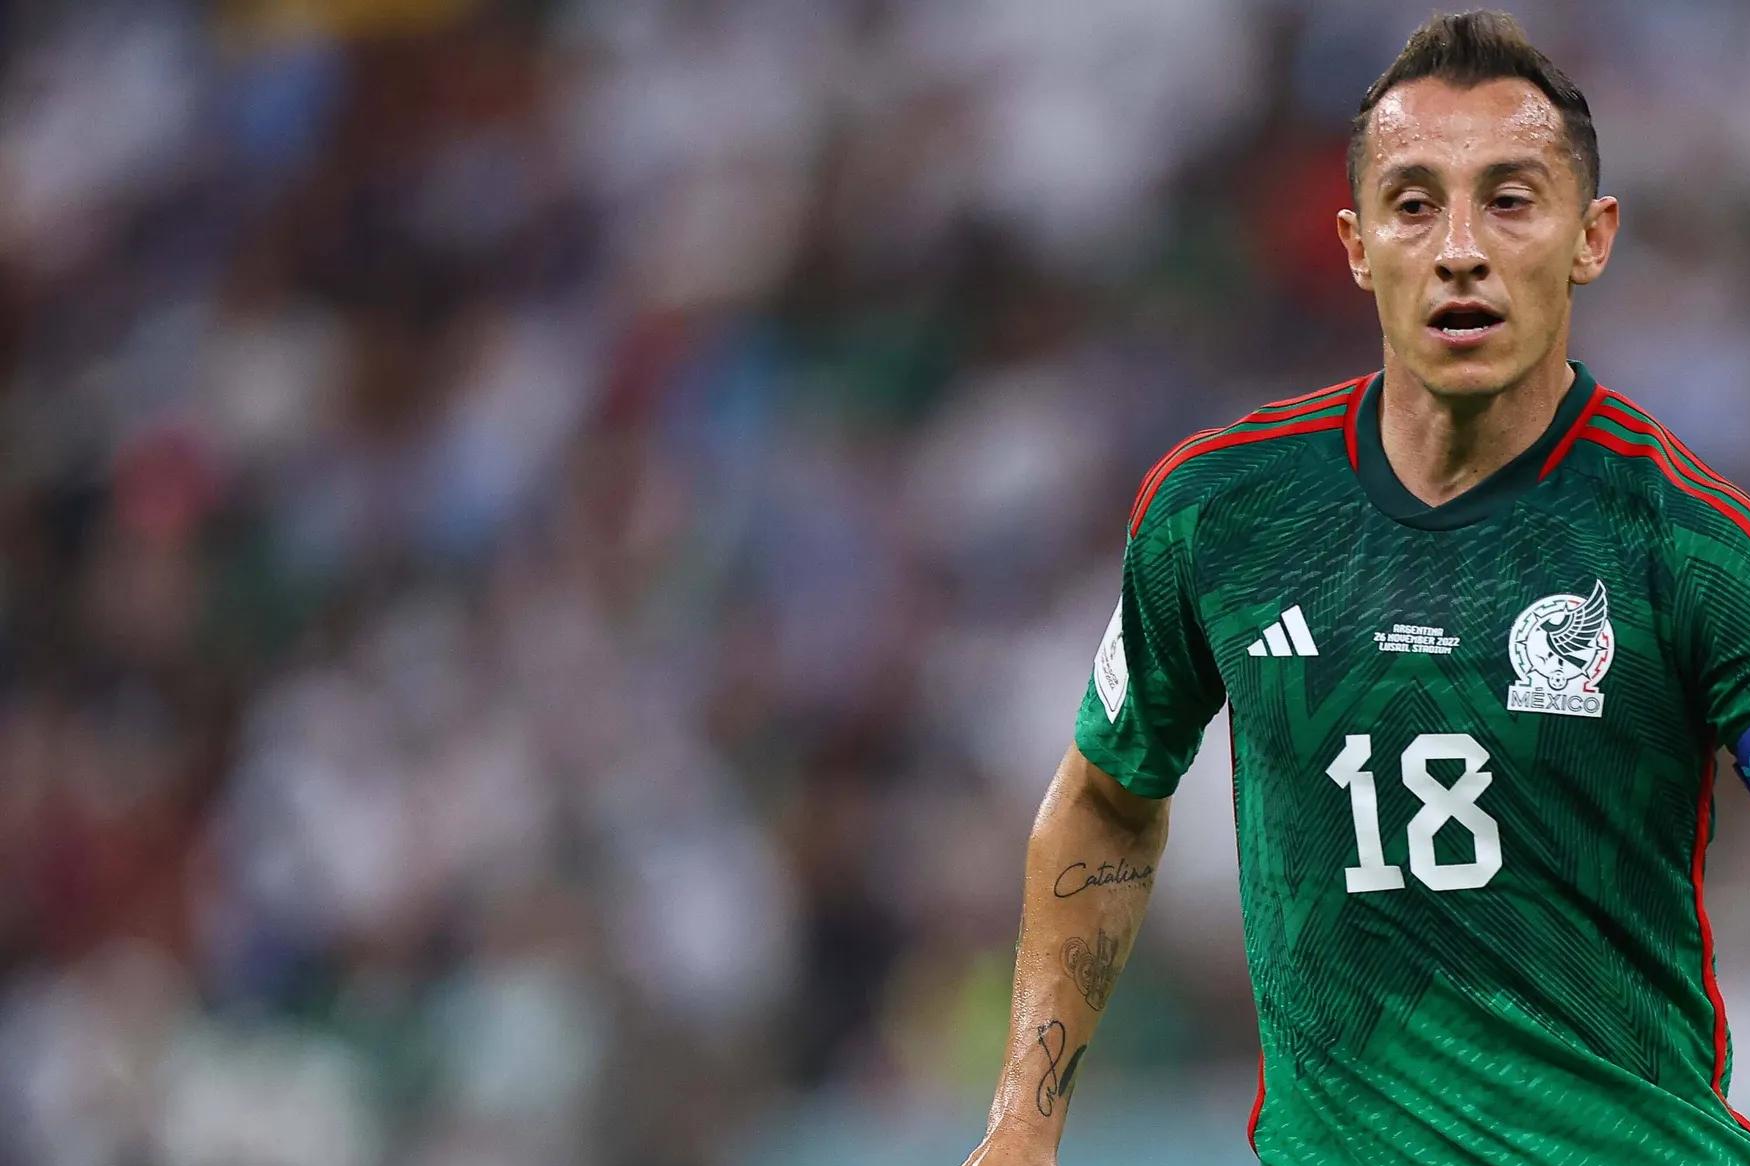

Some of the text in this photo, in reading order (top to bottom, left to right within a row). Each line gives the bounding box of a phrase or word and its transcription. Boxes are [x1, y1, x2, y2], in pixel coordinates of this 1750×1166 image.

[1373, 632, 1460, 647] 26 NOVEMBER 2022
[1393, 624, 1444, 637] ARGENTINA
[1378, 642, 1452, 655] LUSAIL STADIUM
[1510, 686, 1601, 713] MÉXICO
[1325, 733, 1503, 894] 18
[1053, 858, 1153, 899] Catalina
